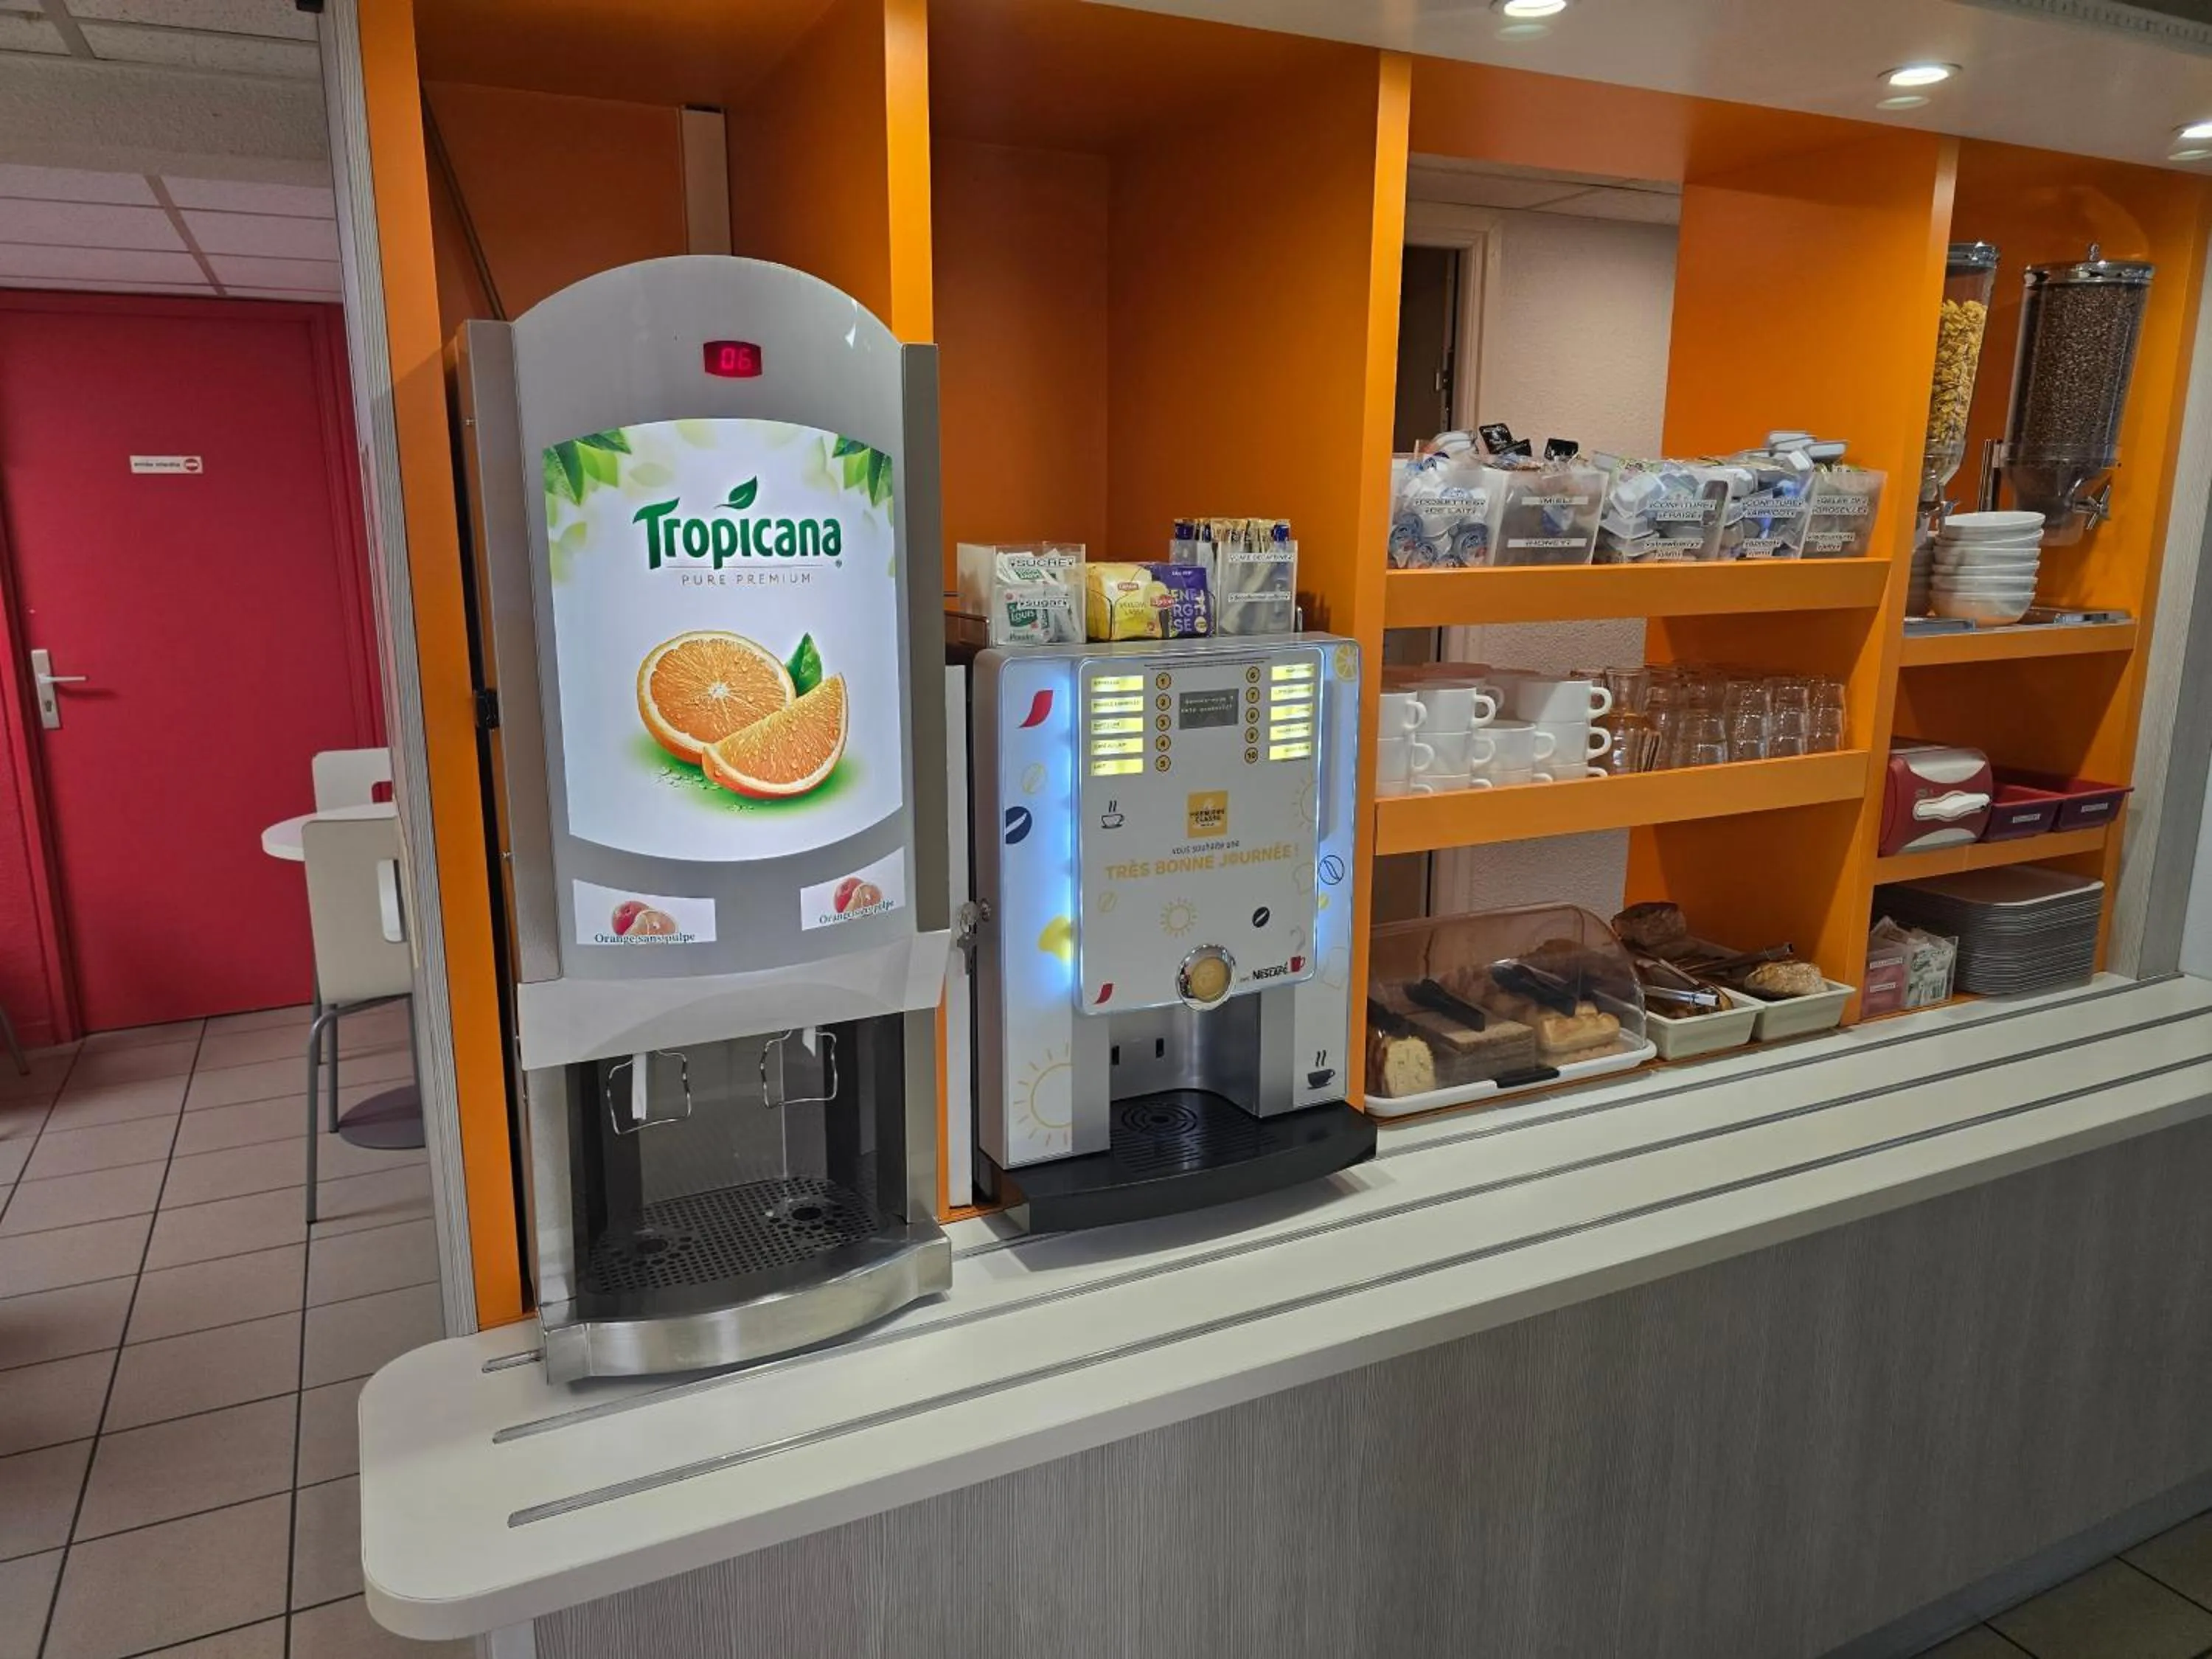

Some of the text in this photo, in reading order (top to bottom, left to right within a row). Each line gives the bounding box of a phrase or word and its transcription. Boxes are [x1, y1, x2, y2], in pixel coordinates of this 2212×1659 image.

[633, 497, 841, 570] Tropicana
[1016, 558, 1067, 568] SUCRE
[682, 573, 811, 585] PURE PREMIUM
[1026, 599, 1061, 608] sugar
[1105, 859, 1150, 880] TRÈS
[1155, 853, 1214, 875] BONNE
[594, 933, 636, 945] Orange
